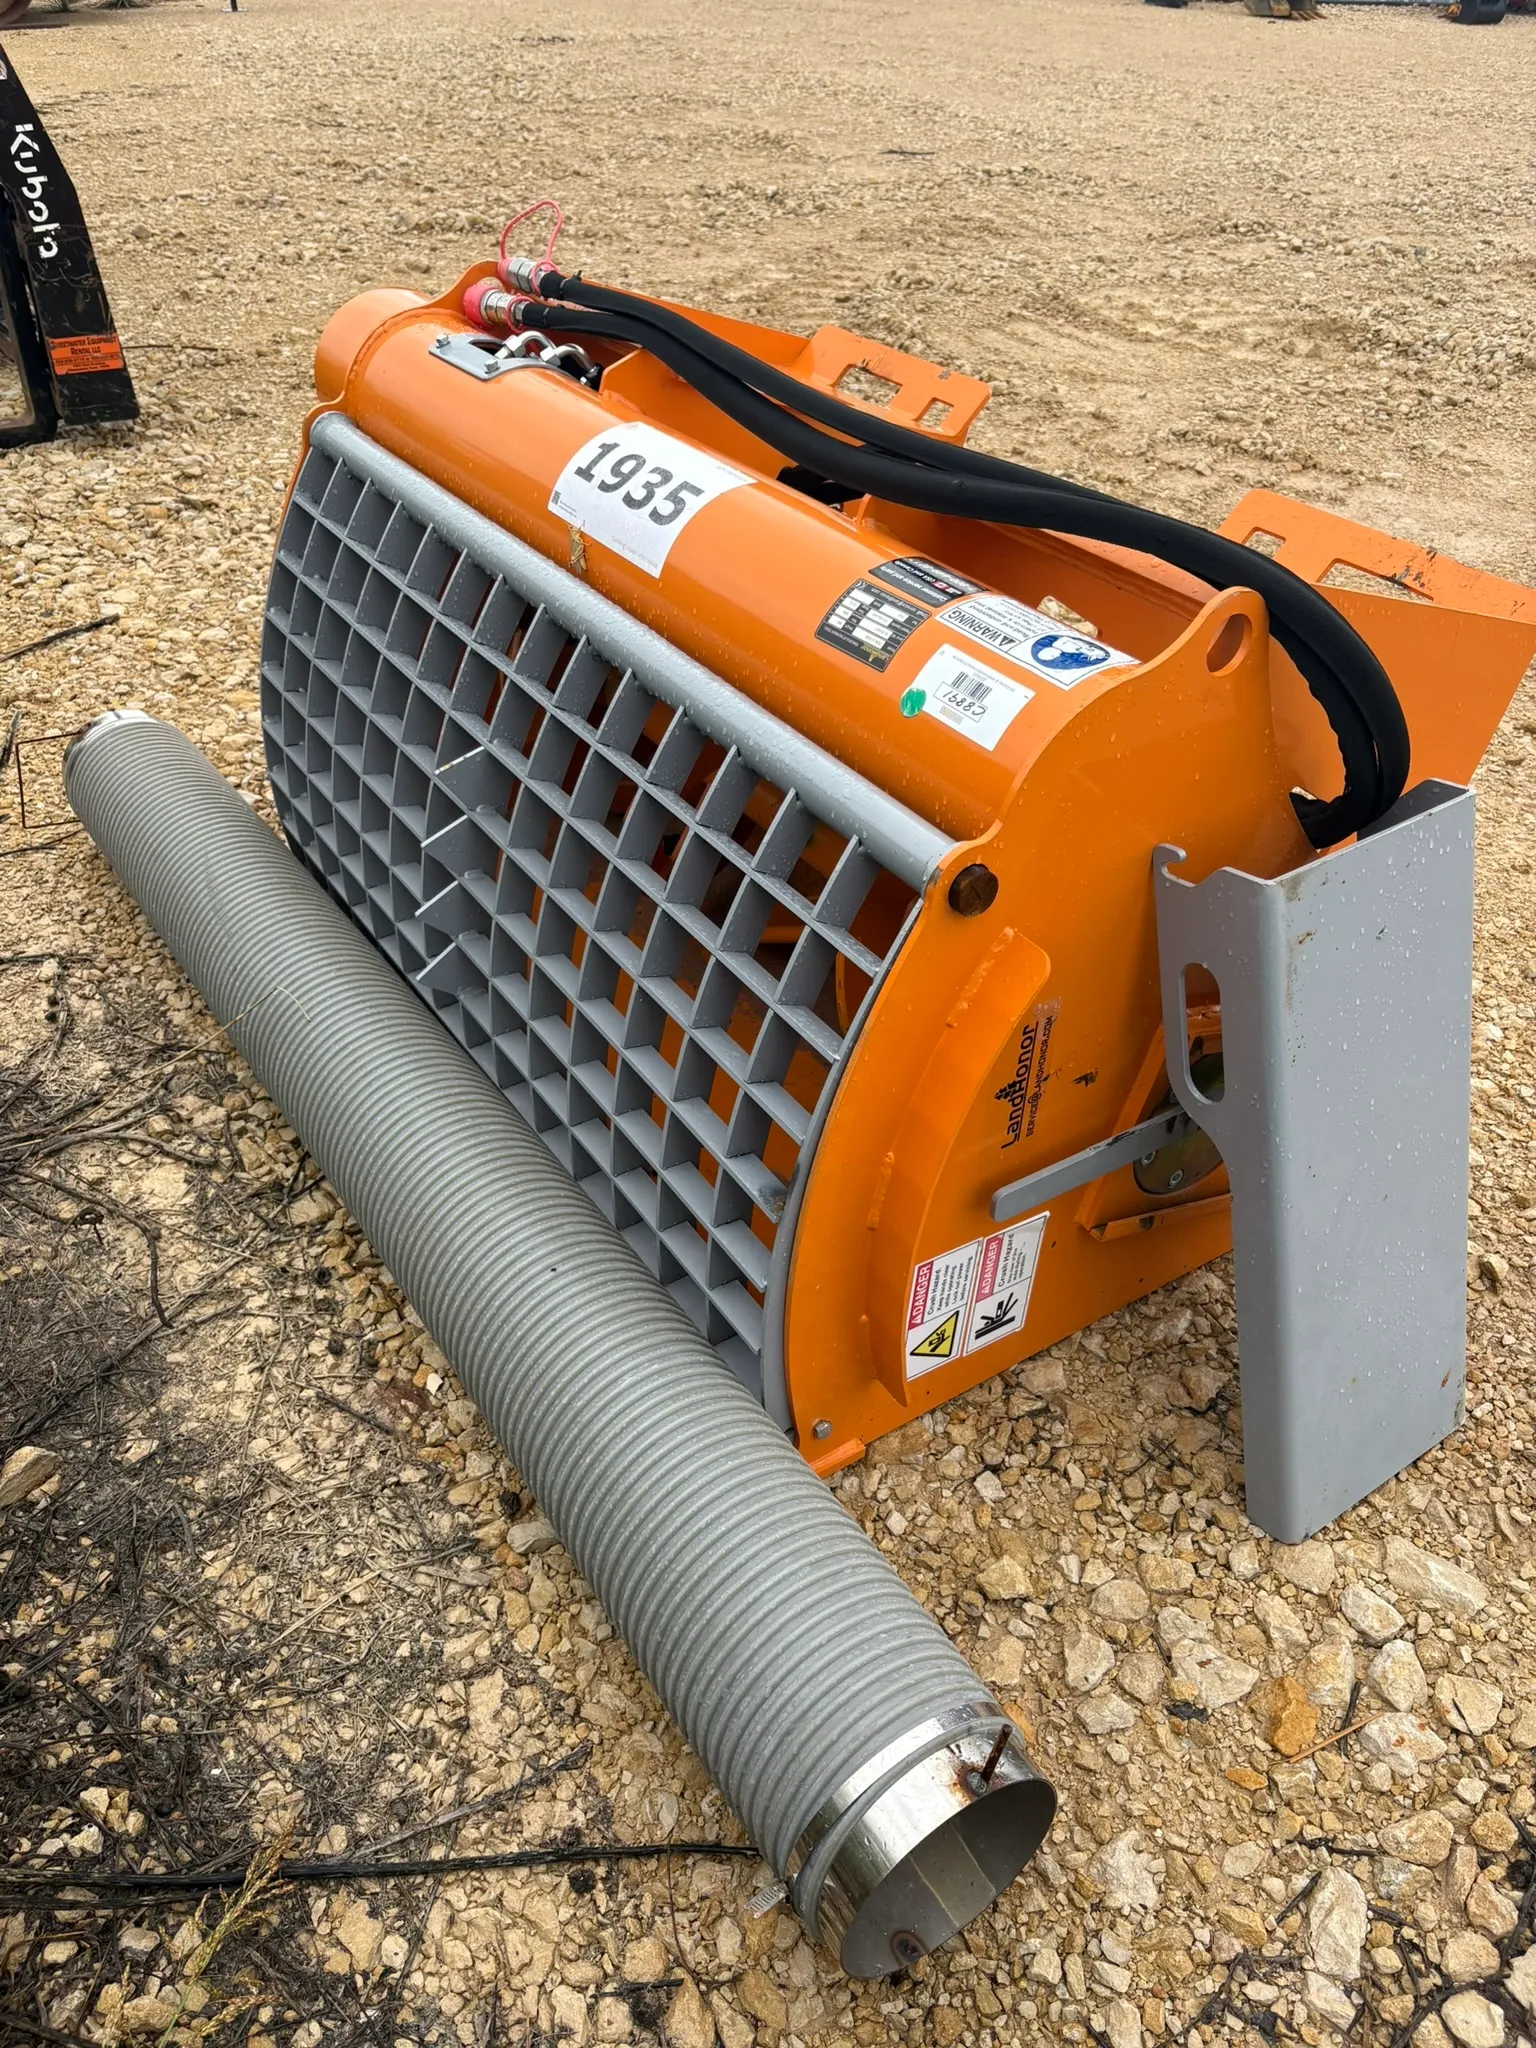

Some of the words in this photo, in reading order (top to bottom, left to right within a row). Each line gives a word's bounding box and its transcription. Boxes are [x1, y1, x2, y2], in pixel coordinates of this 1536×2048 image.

[10, 123, 61, 259] Kubota
[574, 442, 706, 526] 1935
[948, 610, 1003, 642] WARNING
[942, 690, 986, 717] C8891
[1000, 1024, 1036, 1149] LandHonor
[1026, 1015, 1054, 1137] SERVICE@LANDHONOR.COM
[982, 1239, 999, 1287] DANGER
[998, 1263, 1008, 1287] Crush
[1003, 1233, 1015, 1263] Hazard
[913, 1265, 931, 1316] DANGER
[927, 1294, 936, 1315] Crush
